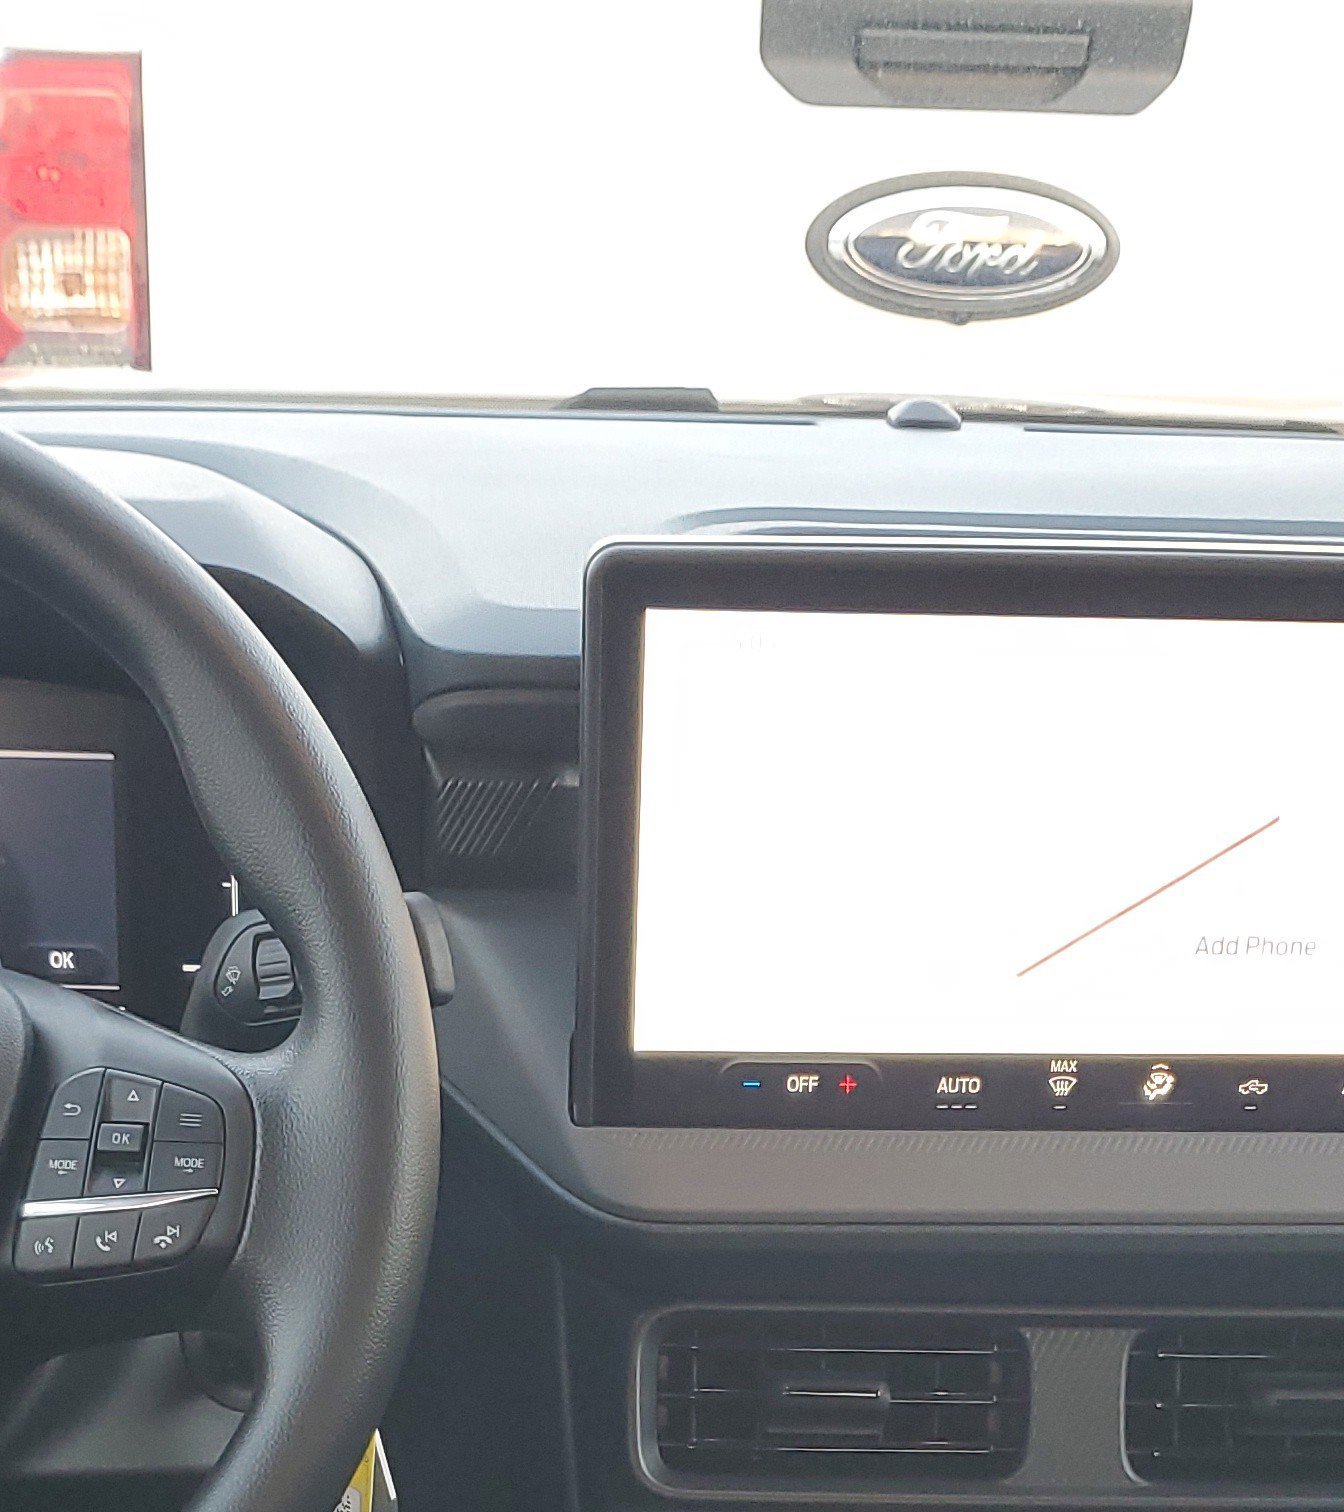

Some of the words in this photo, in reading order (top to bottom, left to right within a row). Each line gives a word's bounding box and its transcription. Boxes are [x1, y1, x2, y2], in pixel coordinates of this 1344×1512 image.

[897, 209, 1045, 276] Ford
[1195, 935, 1239, 956] Add
[1246, 935, 1317, 956] Phone
[48, 951, 75, 969] OK
[1050, 1059, 1078, 1073] MAX
[786, 1075, 820, 1094] OFF
[936, 1076, 981, 1094] AUTO
[111, 1132, 131, 1145] OK
[48, 1159, 79, 1171] MODE
[174, 1156, 205, 1169] MODE
